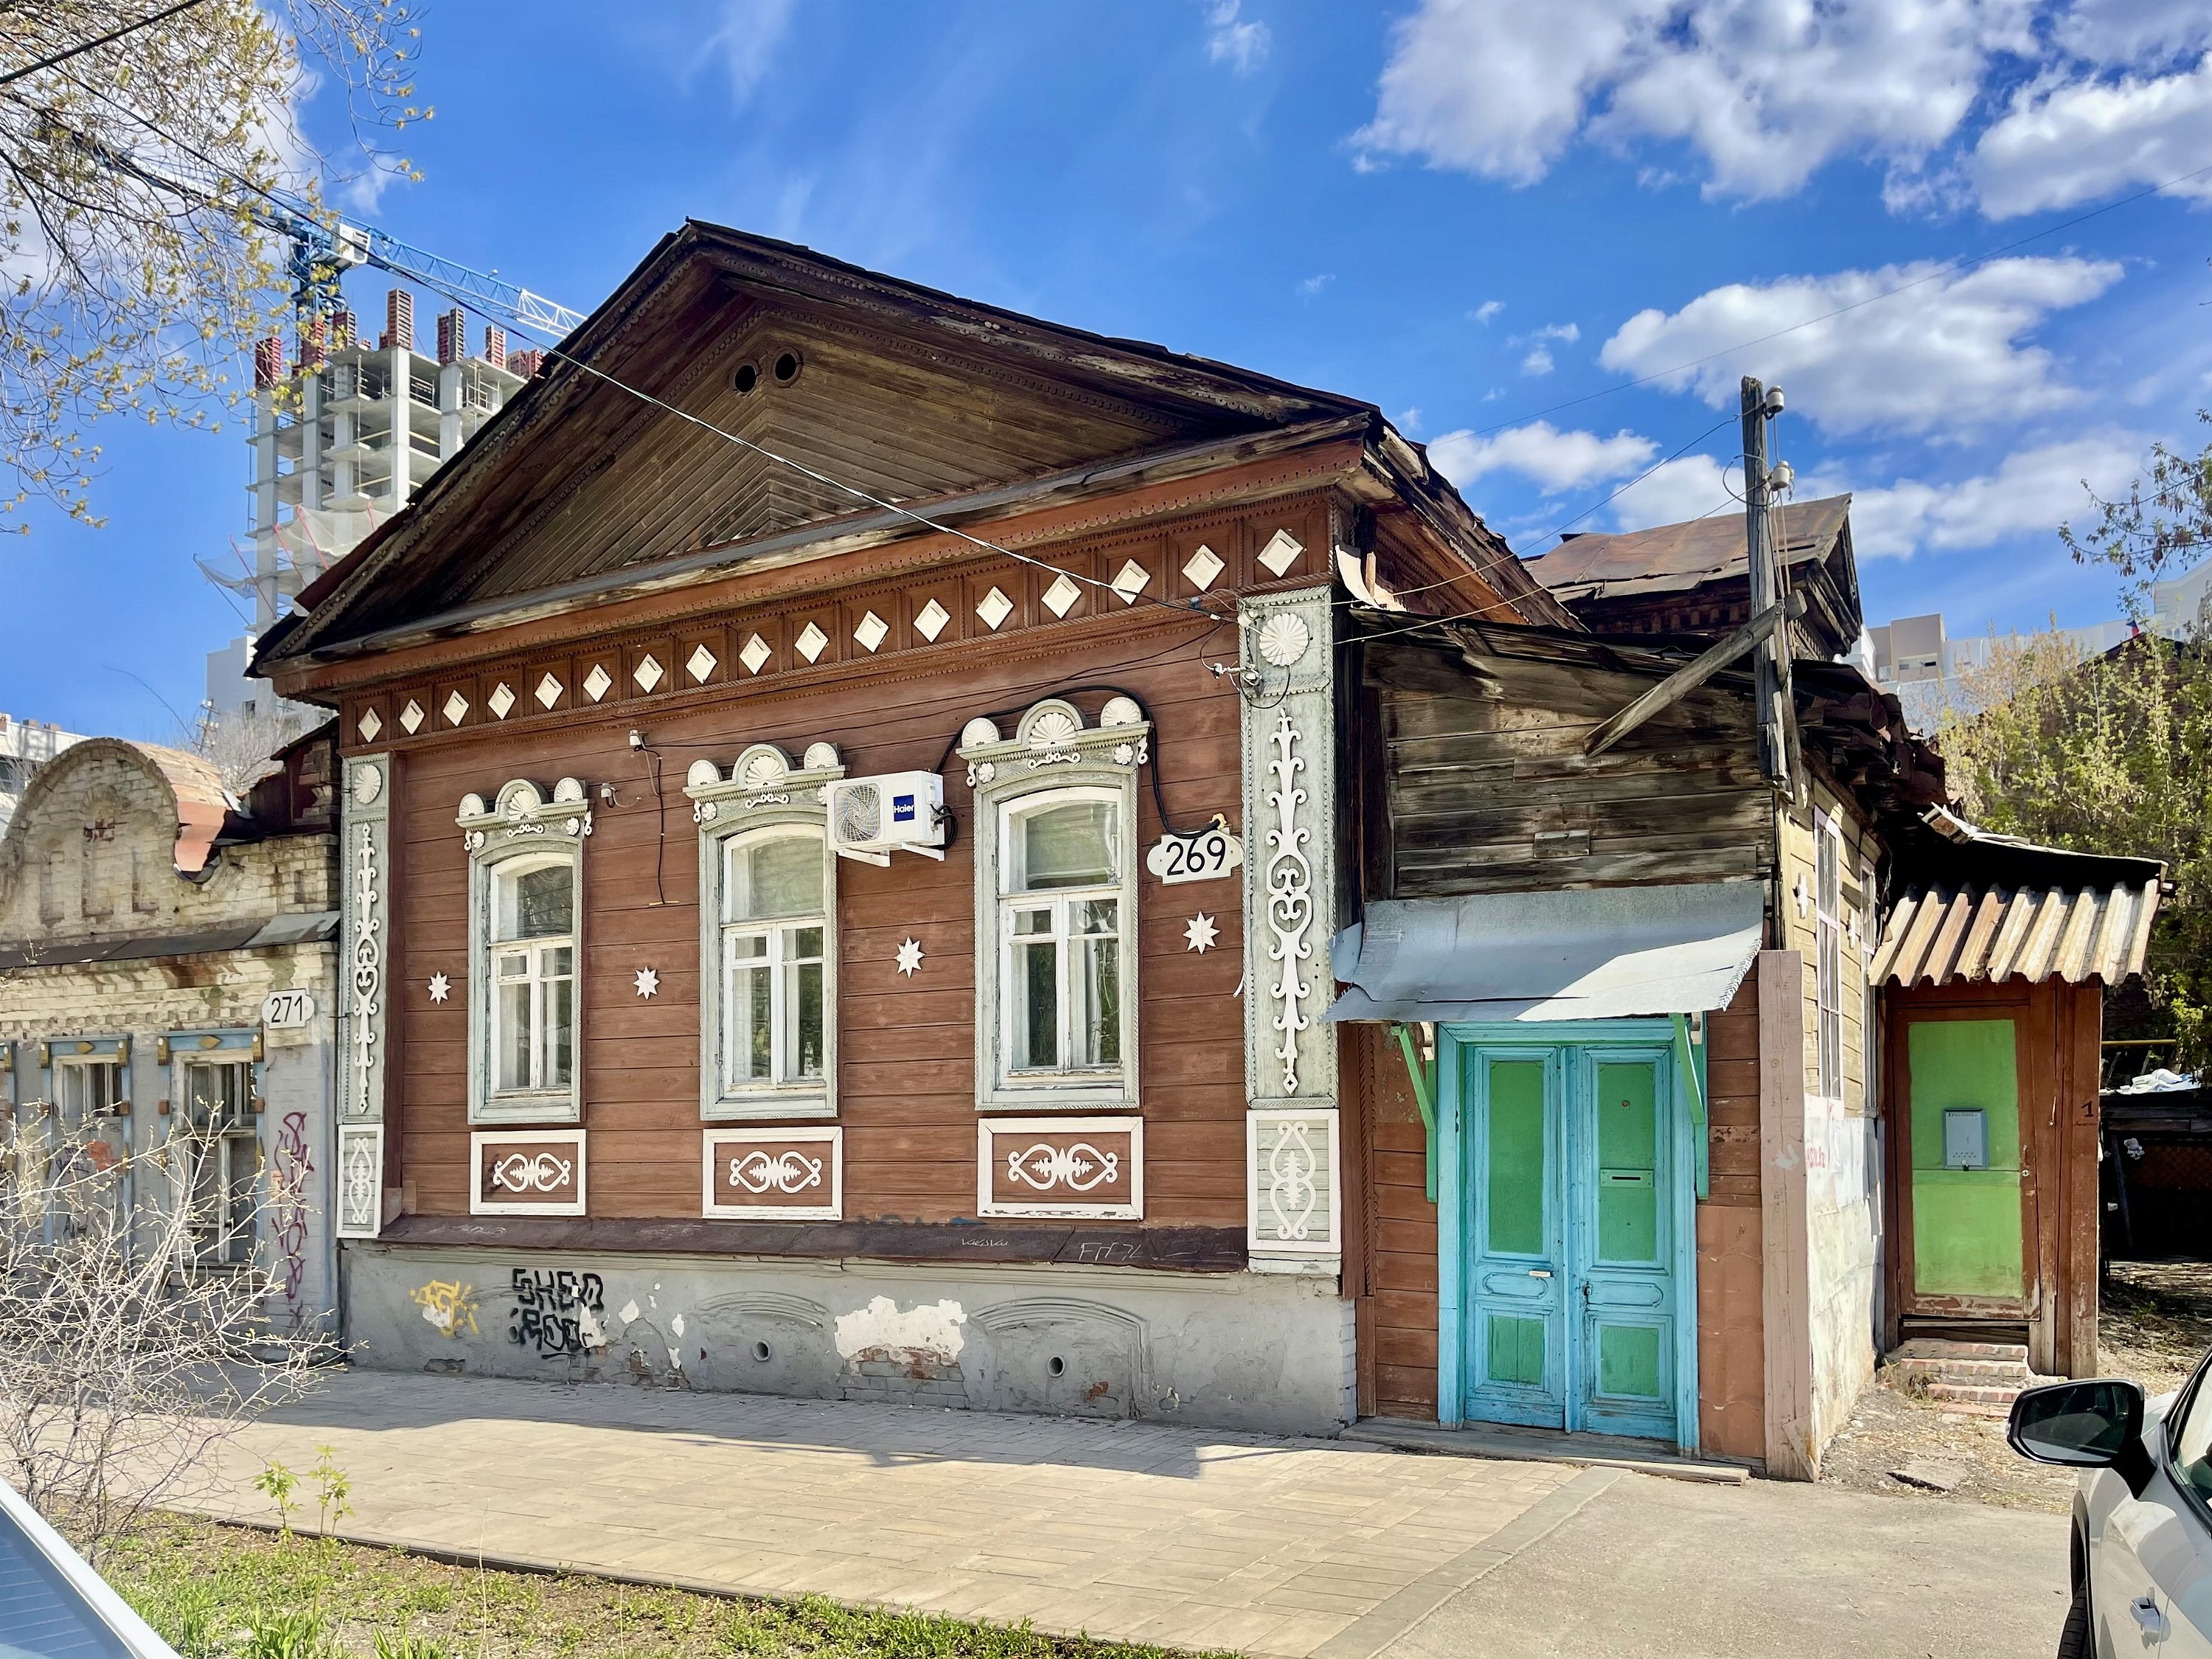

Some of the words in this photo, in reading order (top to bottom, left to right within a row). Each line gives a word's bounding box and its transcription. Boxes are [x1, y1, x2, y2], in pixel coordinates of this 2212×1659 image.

[894, 804, 914, 815] Haier
[1166, 836, 1226, 876] 269
[271, 995, 302, 1023] 271
[2081, 1101, 2094, 1117] 1
